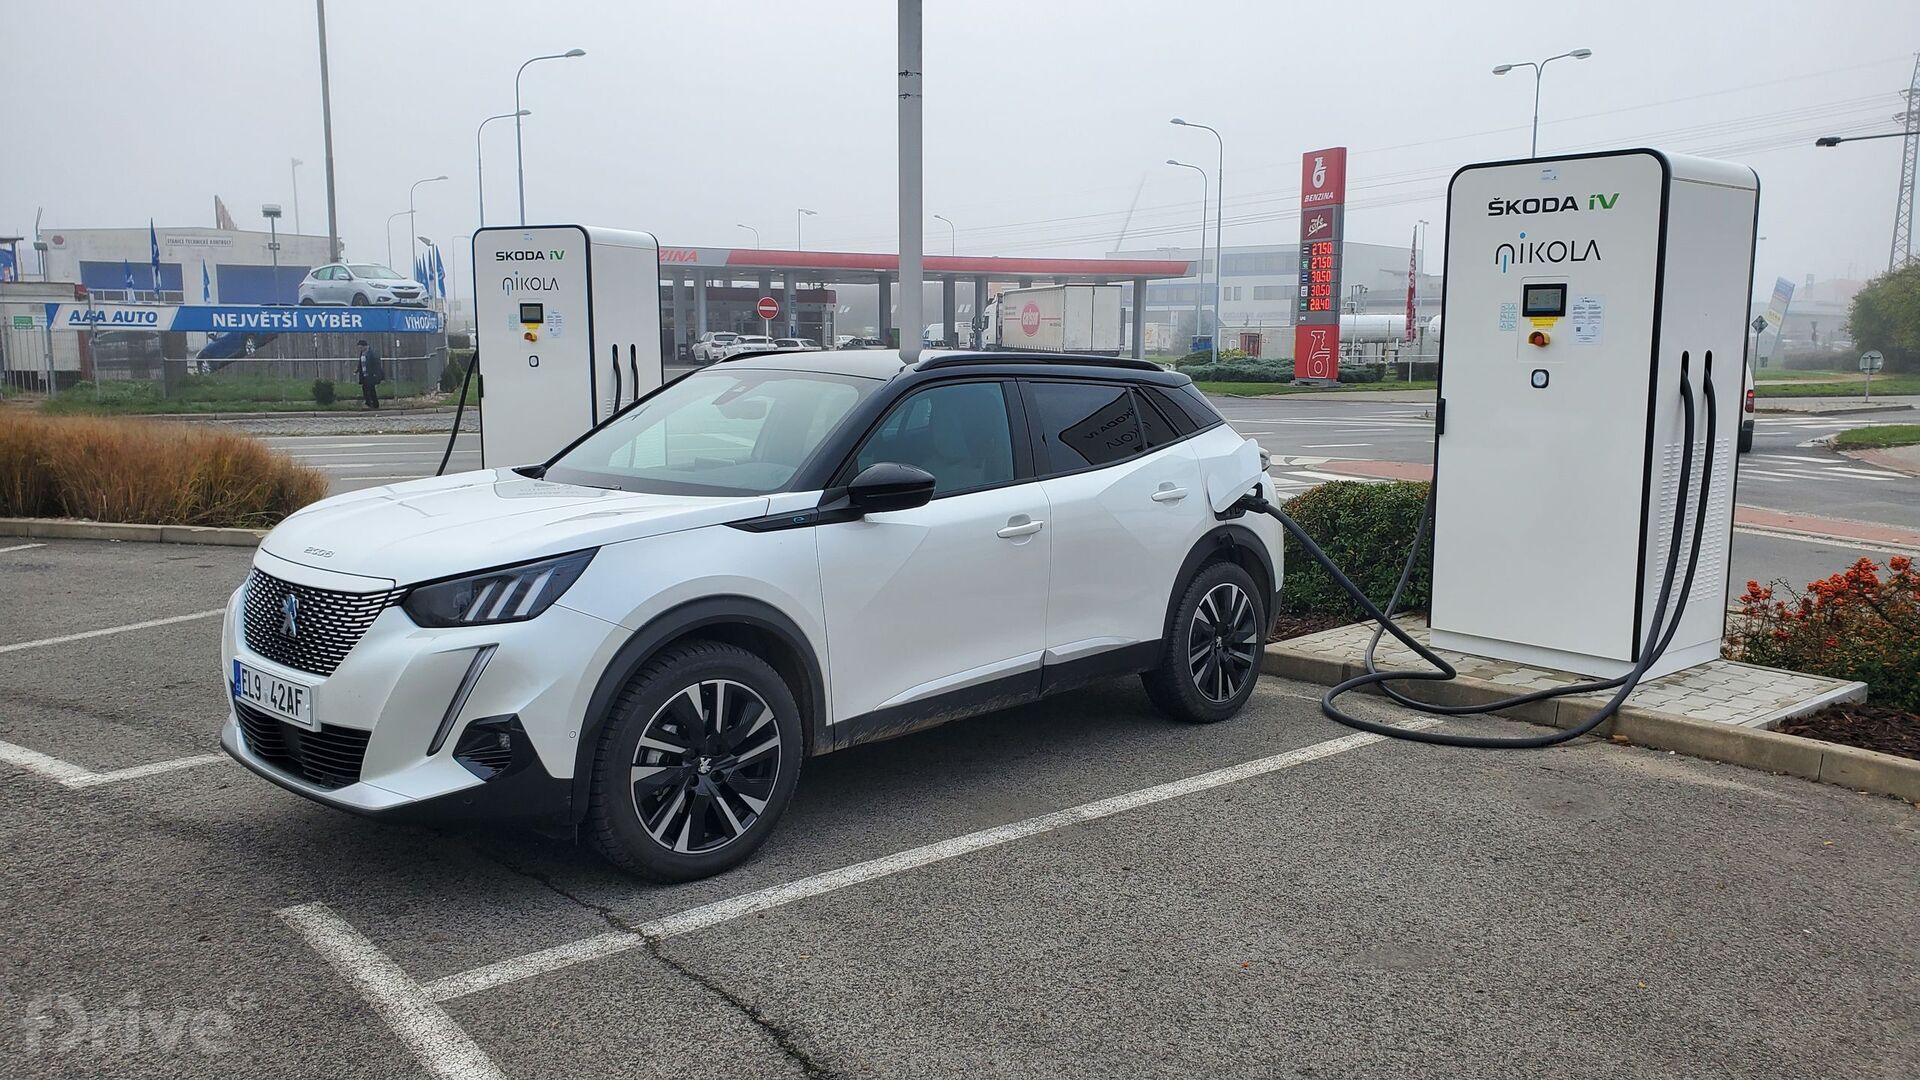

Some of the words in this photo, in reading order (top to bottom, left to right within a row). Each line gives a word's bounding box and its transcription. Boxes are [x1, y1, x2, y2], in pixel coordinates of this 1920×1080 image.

[1304, 192, 1334, 202] BENZINA
[1488, 197, 1579, 216] ŠKODA
[1588, 193, 1620, 210] iV
[69, 310, 107, 322] AAA
[112, 311, 158, 323] AUTO
[212, 311, 298, 328] NEJVĚTŠÍ
[305, 312, 363, 328] VÝBĚR
[241, 667, 261, 701] EL9
[270, 681, 303, 716] 42AF
